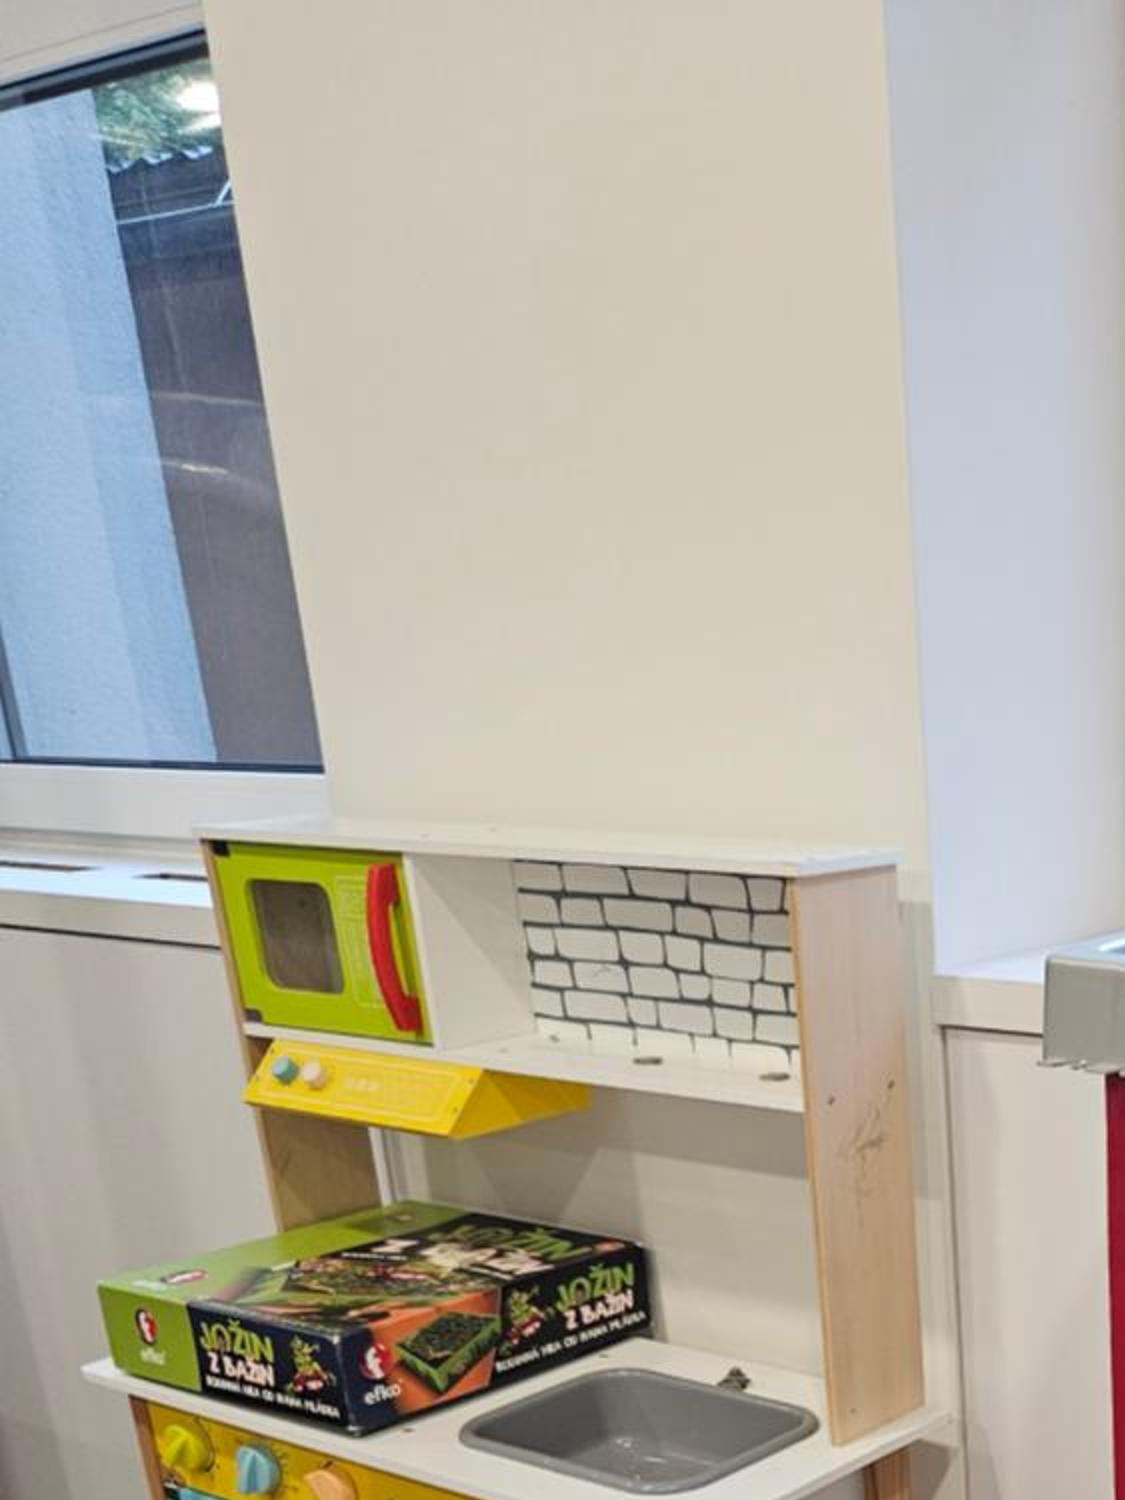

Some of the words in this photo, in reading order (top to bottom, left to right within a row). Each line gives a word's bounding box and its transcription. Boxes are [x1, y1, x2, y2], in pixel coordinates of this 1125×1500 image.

[556, 1262, 635, 1313] JOŽIN
[563, 1309, 578, 1330] Z
[580, 1288, 634, 1326] BAŽIN
[200, 1318, 275, 1362] JOŽIN
[207, 1352, 221, 1374] Z
[223, 1352, 276, 1387] BAŽIN
[364, 1384, 401, 1406] efko
